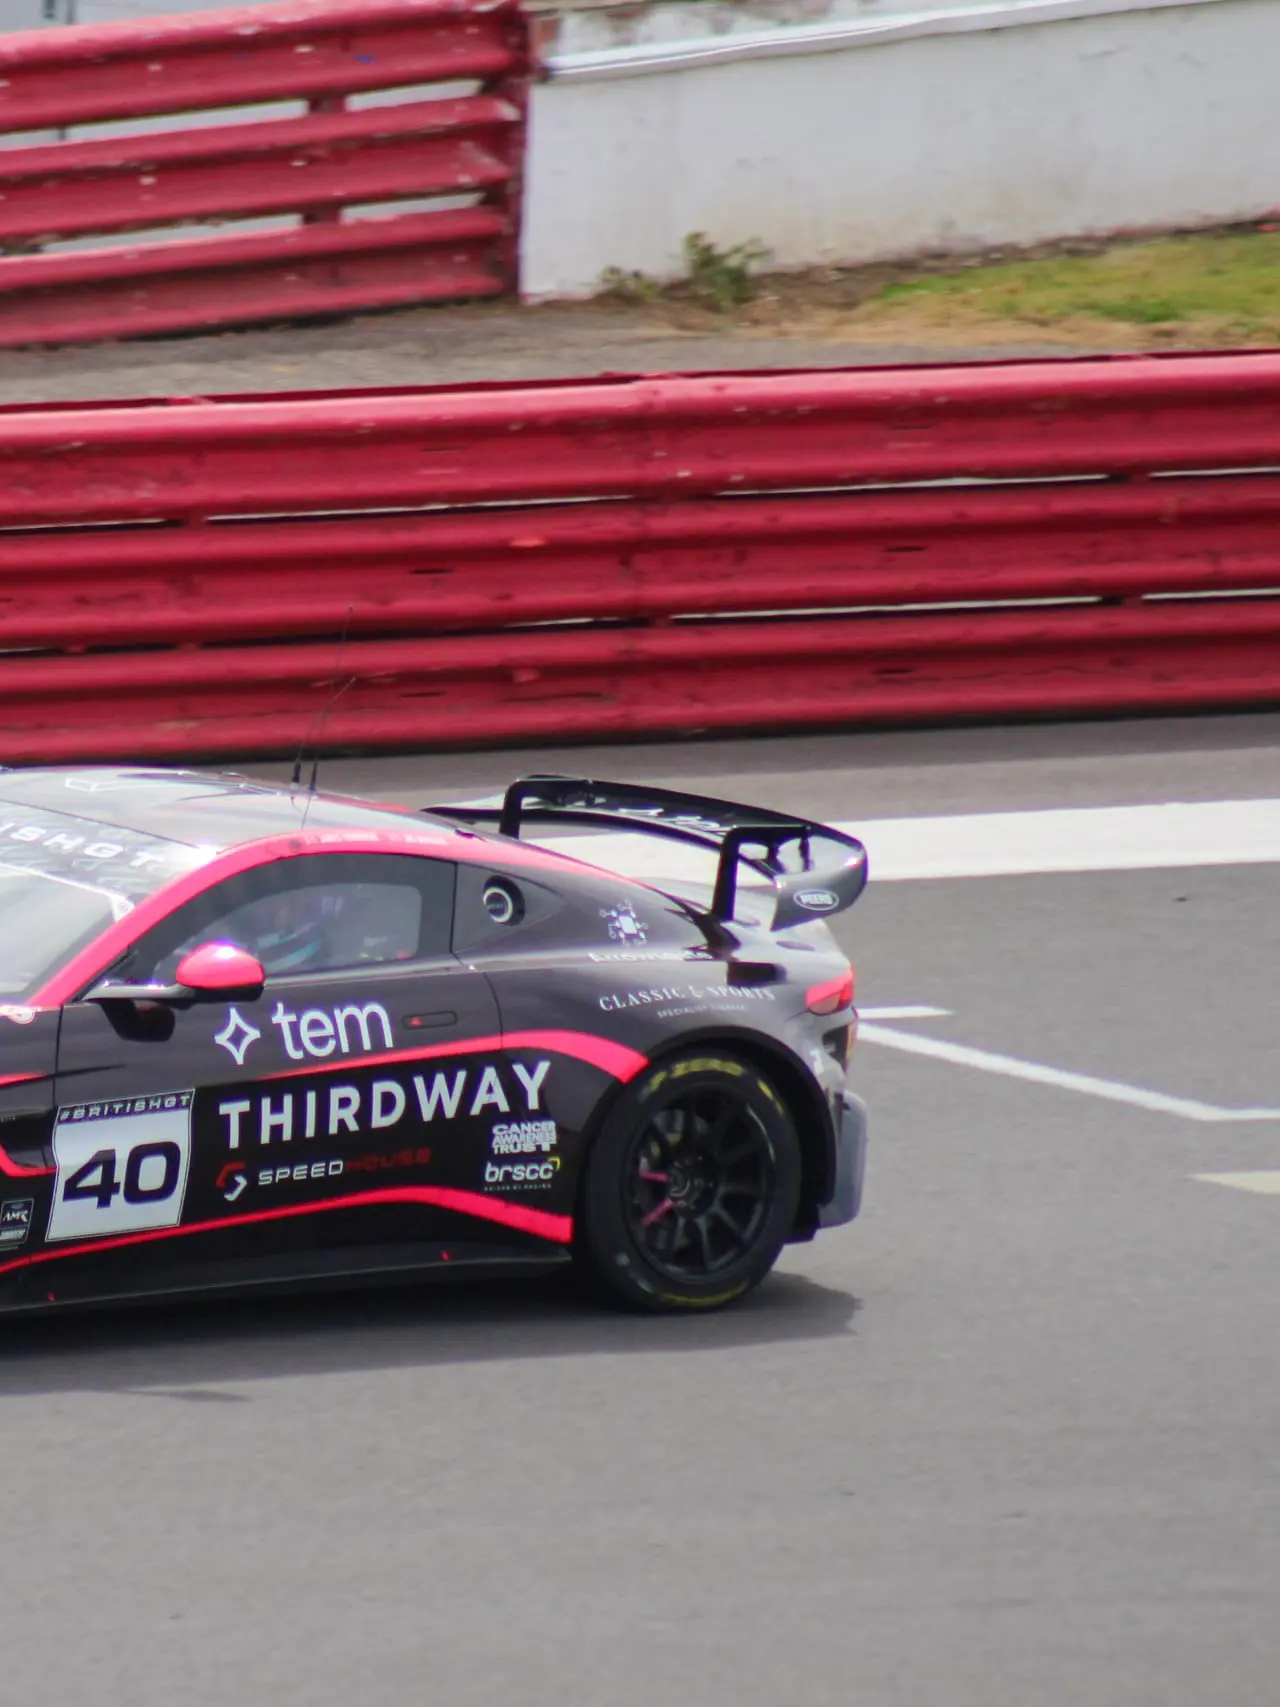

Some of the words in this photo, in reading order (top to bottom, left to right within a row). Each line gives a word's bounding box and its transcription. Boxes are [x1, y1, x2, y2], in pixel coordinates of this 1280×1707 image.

[598, 986, 686, 1011] CLASSIC
[271, 1002, 394, 1060] tem
[60, 1094, 191, 1121] #BRITISHGT
[218, 1060, 551, 1150] THIRDWAY
[492, 1120, 557, 1136] CANCER
[493, 1142, 552, 1155] TRUST
[62, 1140, 182, 1210] 40
[484, 1160, 554, 1183] brscc
